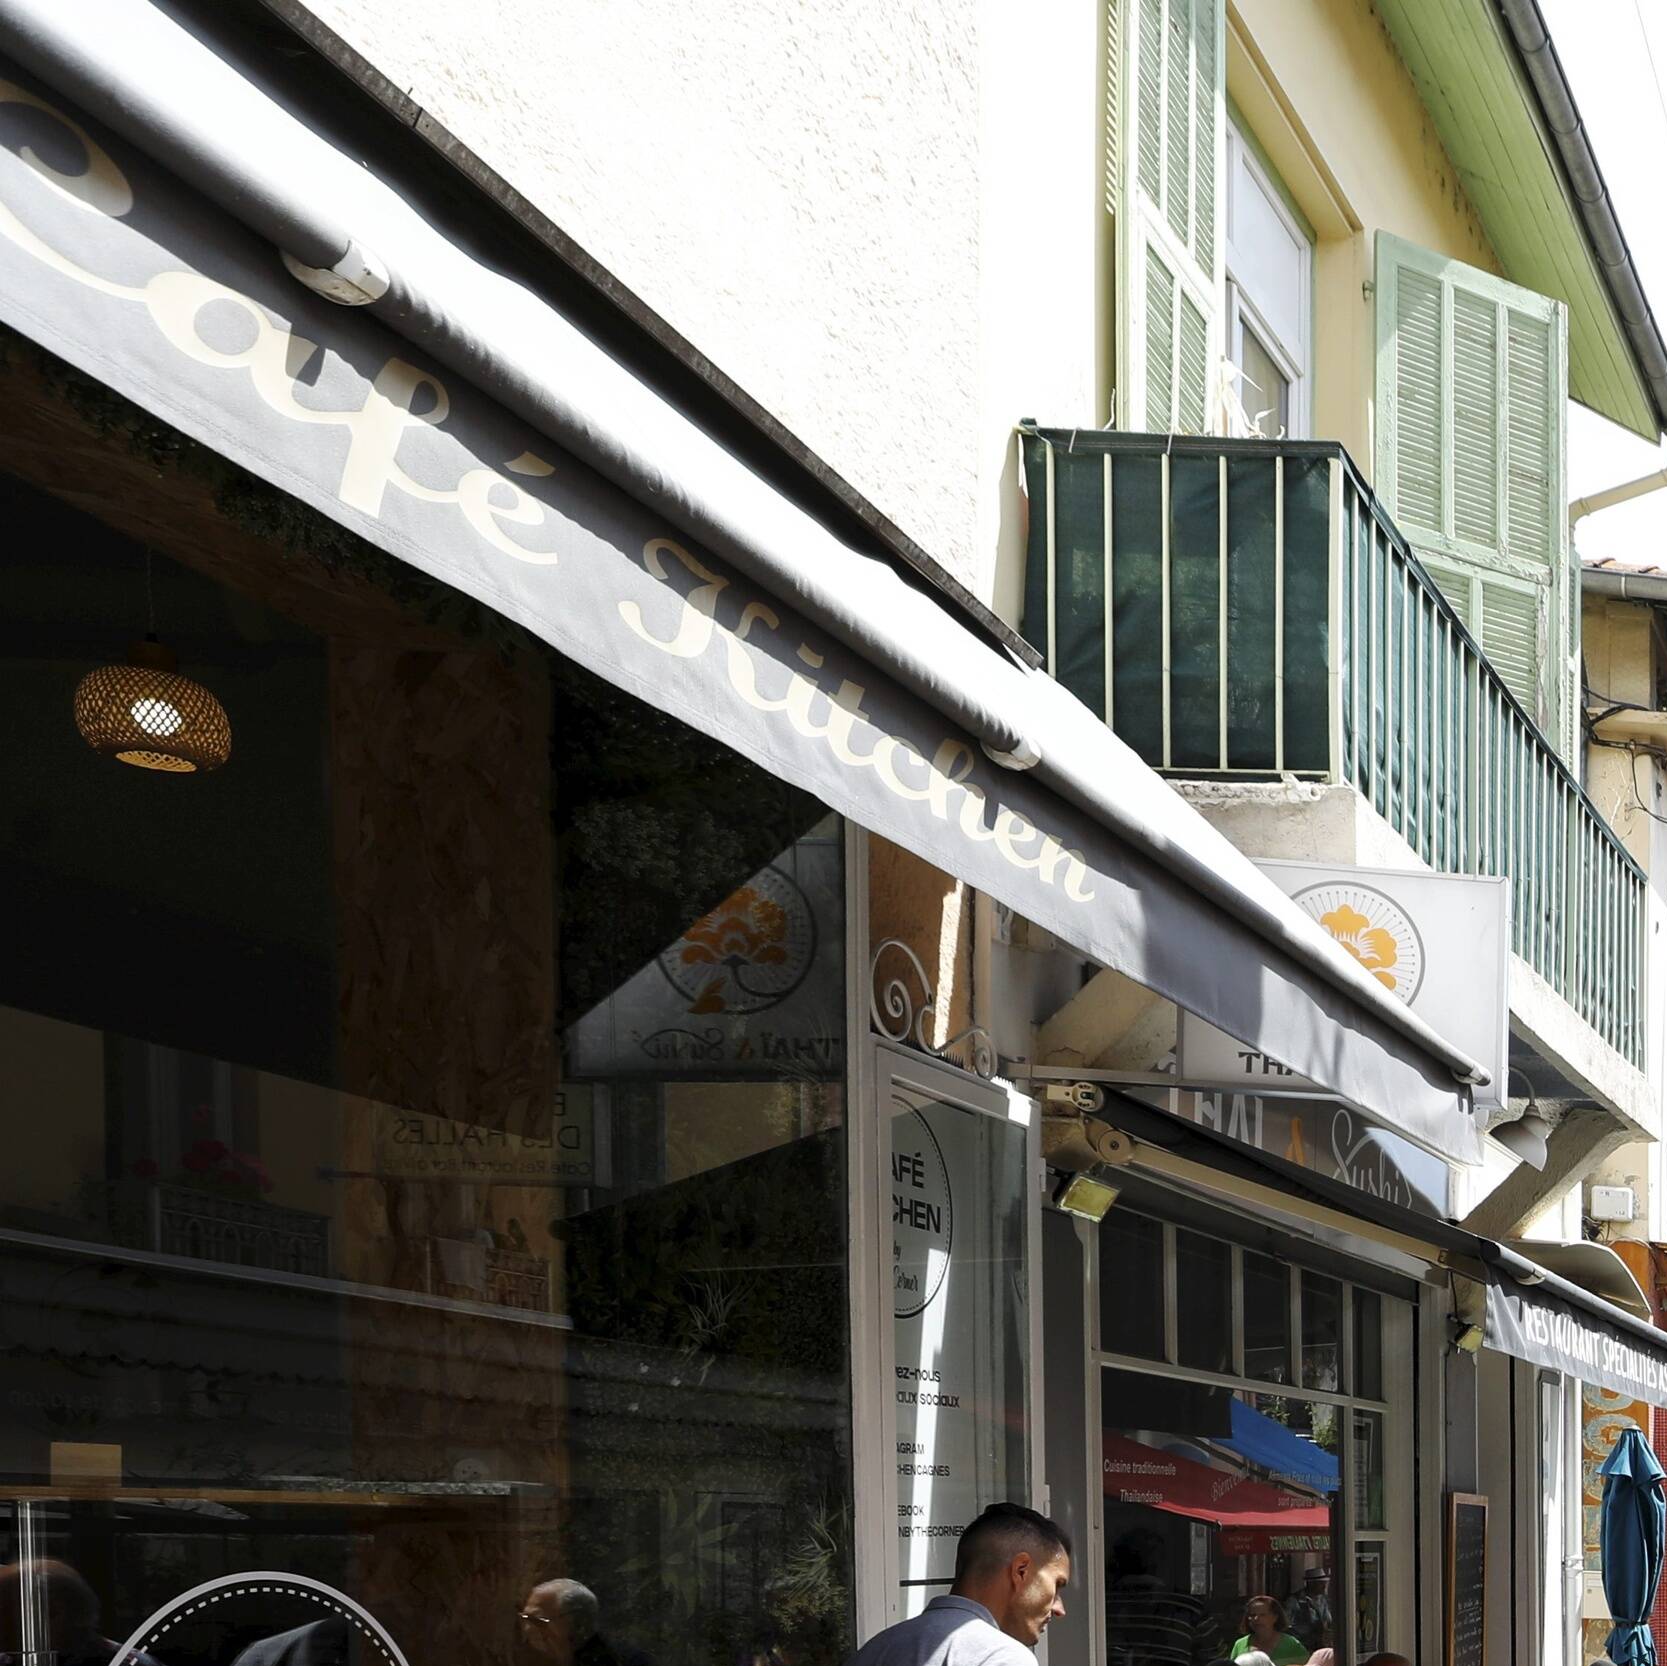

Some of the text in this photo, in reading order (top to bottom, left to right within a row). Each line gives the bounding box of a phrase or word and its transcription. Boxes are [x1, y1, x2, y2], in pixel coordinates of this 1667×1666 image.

[617, 537, 1095, 902] Kitchen
[1238, 1051, 1293, 1075] TH
[1521, 1299, 1600, 1368] RESTAURANT
[1601, 1335, 1658, 1389] SPÉCIALITÉS
[895, 1365, 941, 1382] ez-nous
[1104, 1458, 1177, 1476] Cuisine traditionnelle
